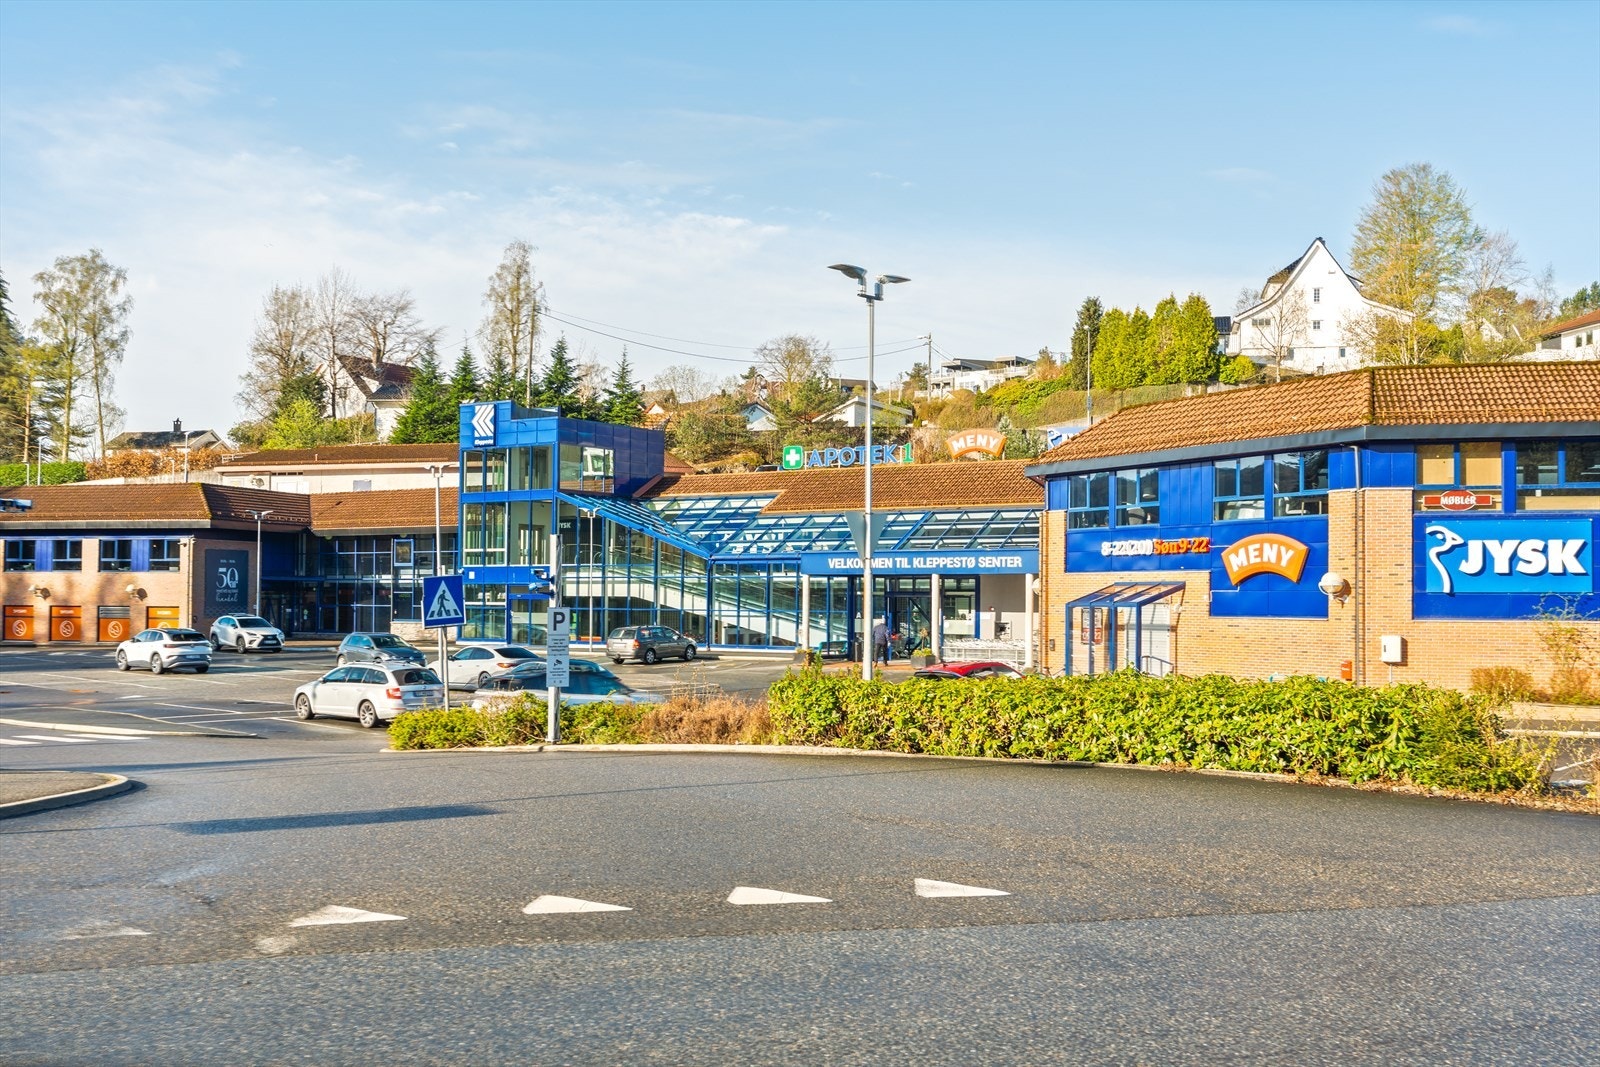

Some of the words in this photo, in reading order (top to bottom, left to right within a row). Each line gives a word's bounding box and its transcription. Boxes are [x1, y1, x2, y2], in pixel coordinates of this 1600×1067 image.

[951, 433, 1000, 452] MENY
[807, 443, 898, 468] APOTEK
[901, 442, 915, 464] 1
[828, 557, 893, 569] VELKOMEN
[895, 557, 911, 569] TIL
[913, 556, 976, 569] KLEPPESTØ
[978, 556, 1022, 568] SENTER
[1228, 541, 1296, 573] MENY
[1458, 538, 1588, 575] JYSK
[216, 567, 239, 589] 50
[553, 611, 565, 631] P
